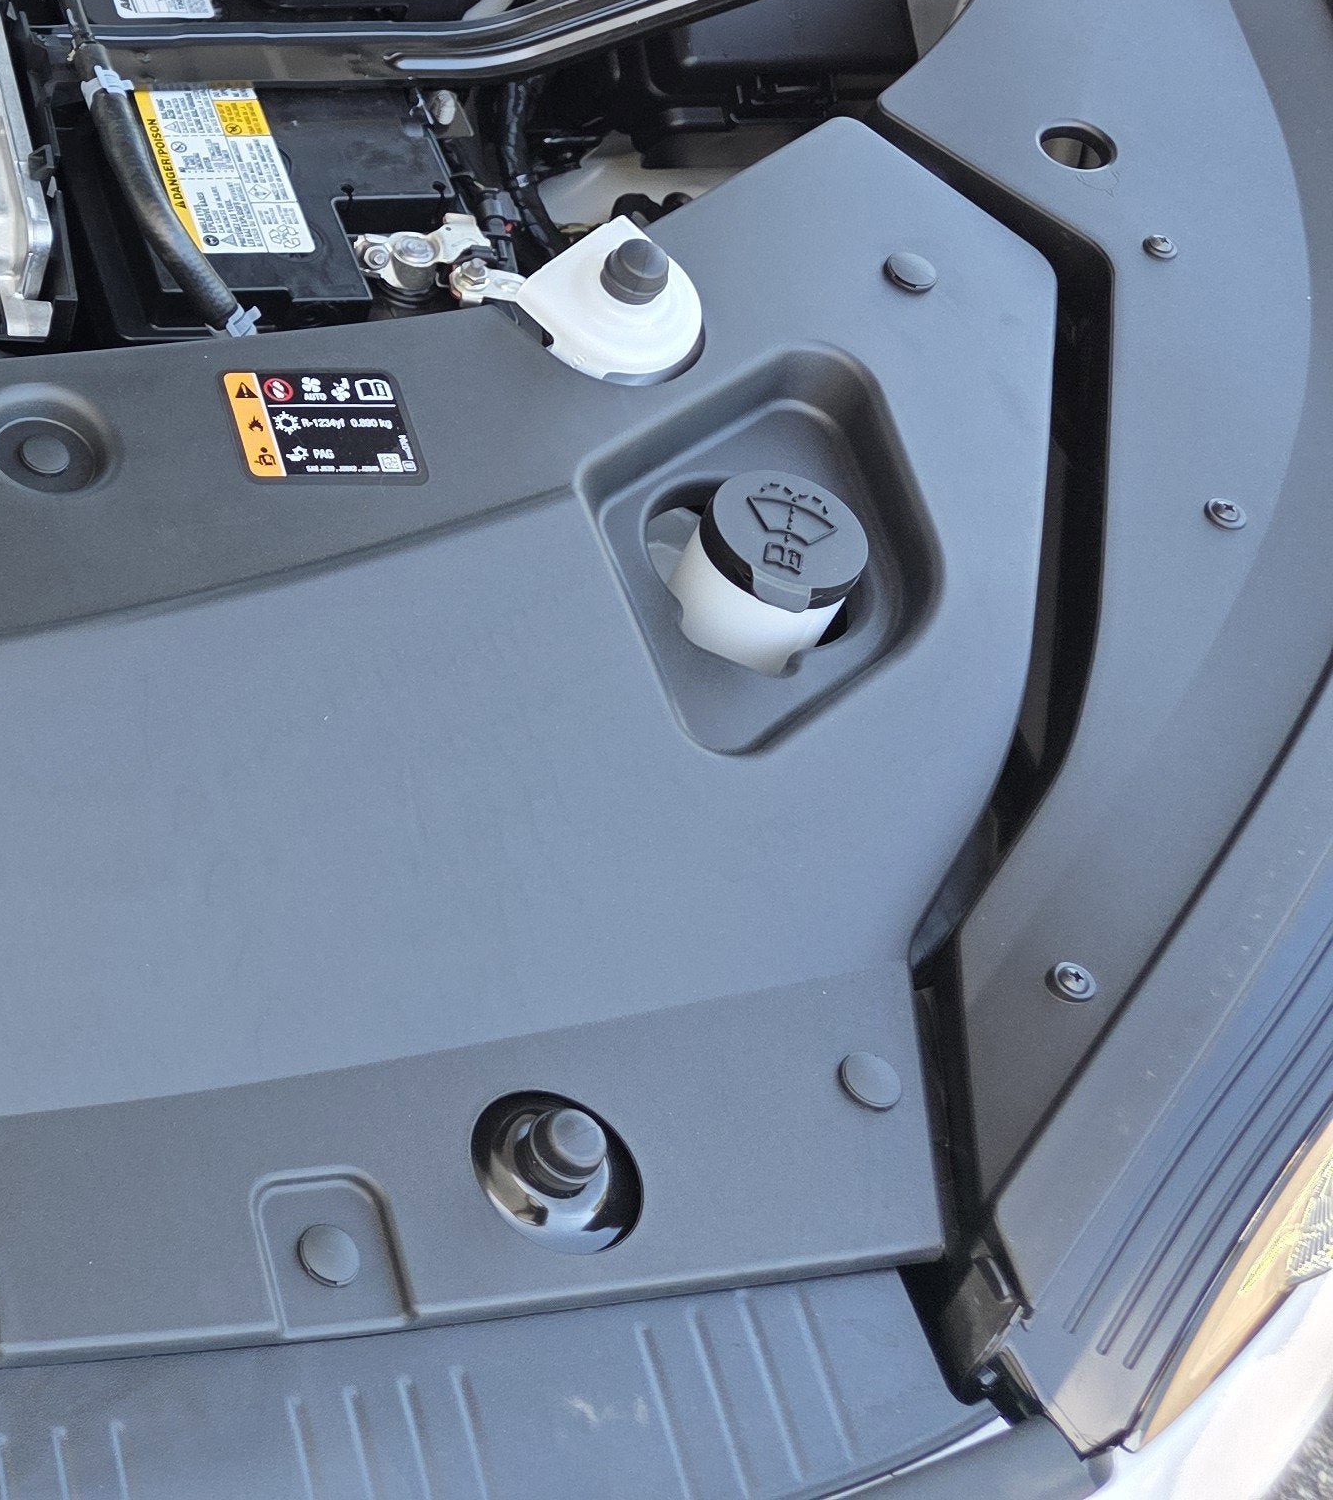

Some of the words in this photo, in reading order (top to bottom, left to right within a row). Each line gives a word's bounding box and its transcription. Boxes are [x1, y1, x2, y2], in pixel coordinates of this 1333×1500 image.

[145, 117, 186, 200] DANGER/POISON
[303, 392, 327, 401] AUTO
[378, 418, 393, 430] kg
[313, 448, 335, 459] PAG
